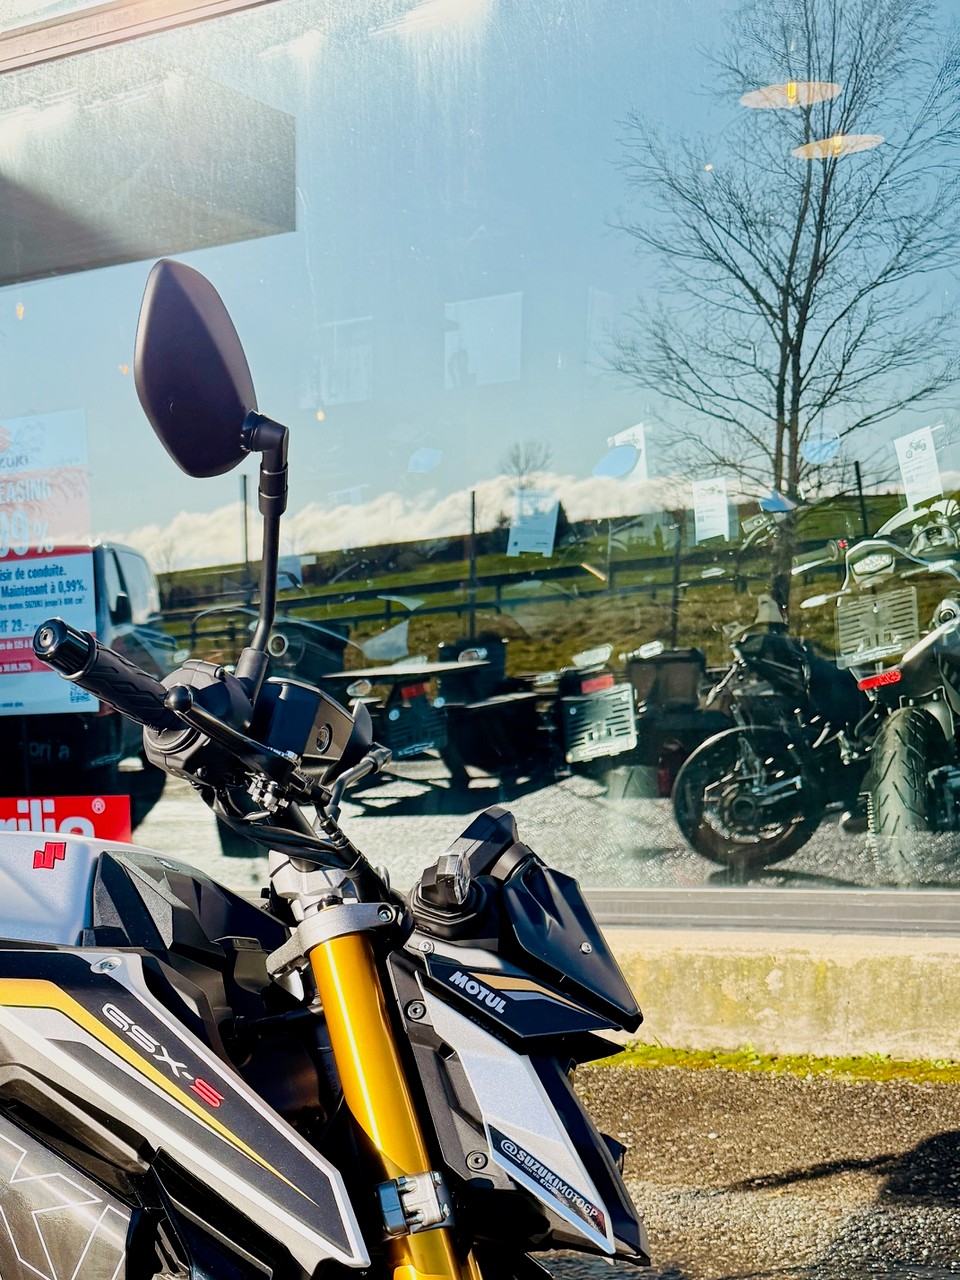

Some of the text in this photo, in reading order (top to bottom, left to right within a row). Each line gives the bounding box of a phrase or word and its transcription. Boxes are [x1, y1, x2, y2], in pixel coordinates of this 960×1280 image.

[1, 583, 48, 598] Maintenant
[15, 567, 25, 580] de
[448, 970, 508, 1015] MOTUL
[102, 1002, 225, 1108] GSX-S
[500, 1138, 599, 1218] @SUZUKIMOTOGP
